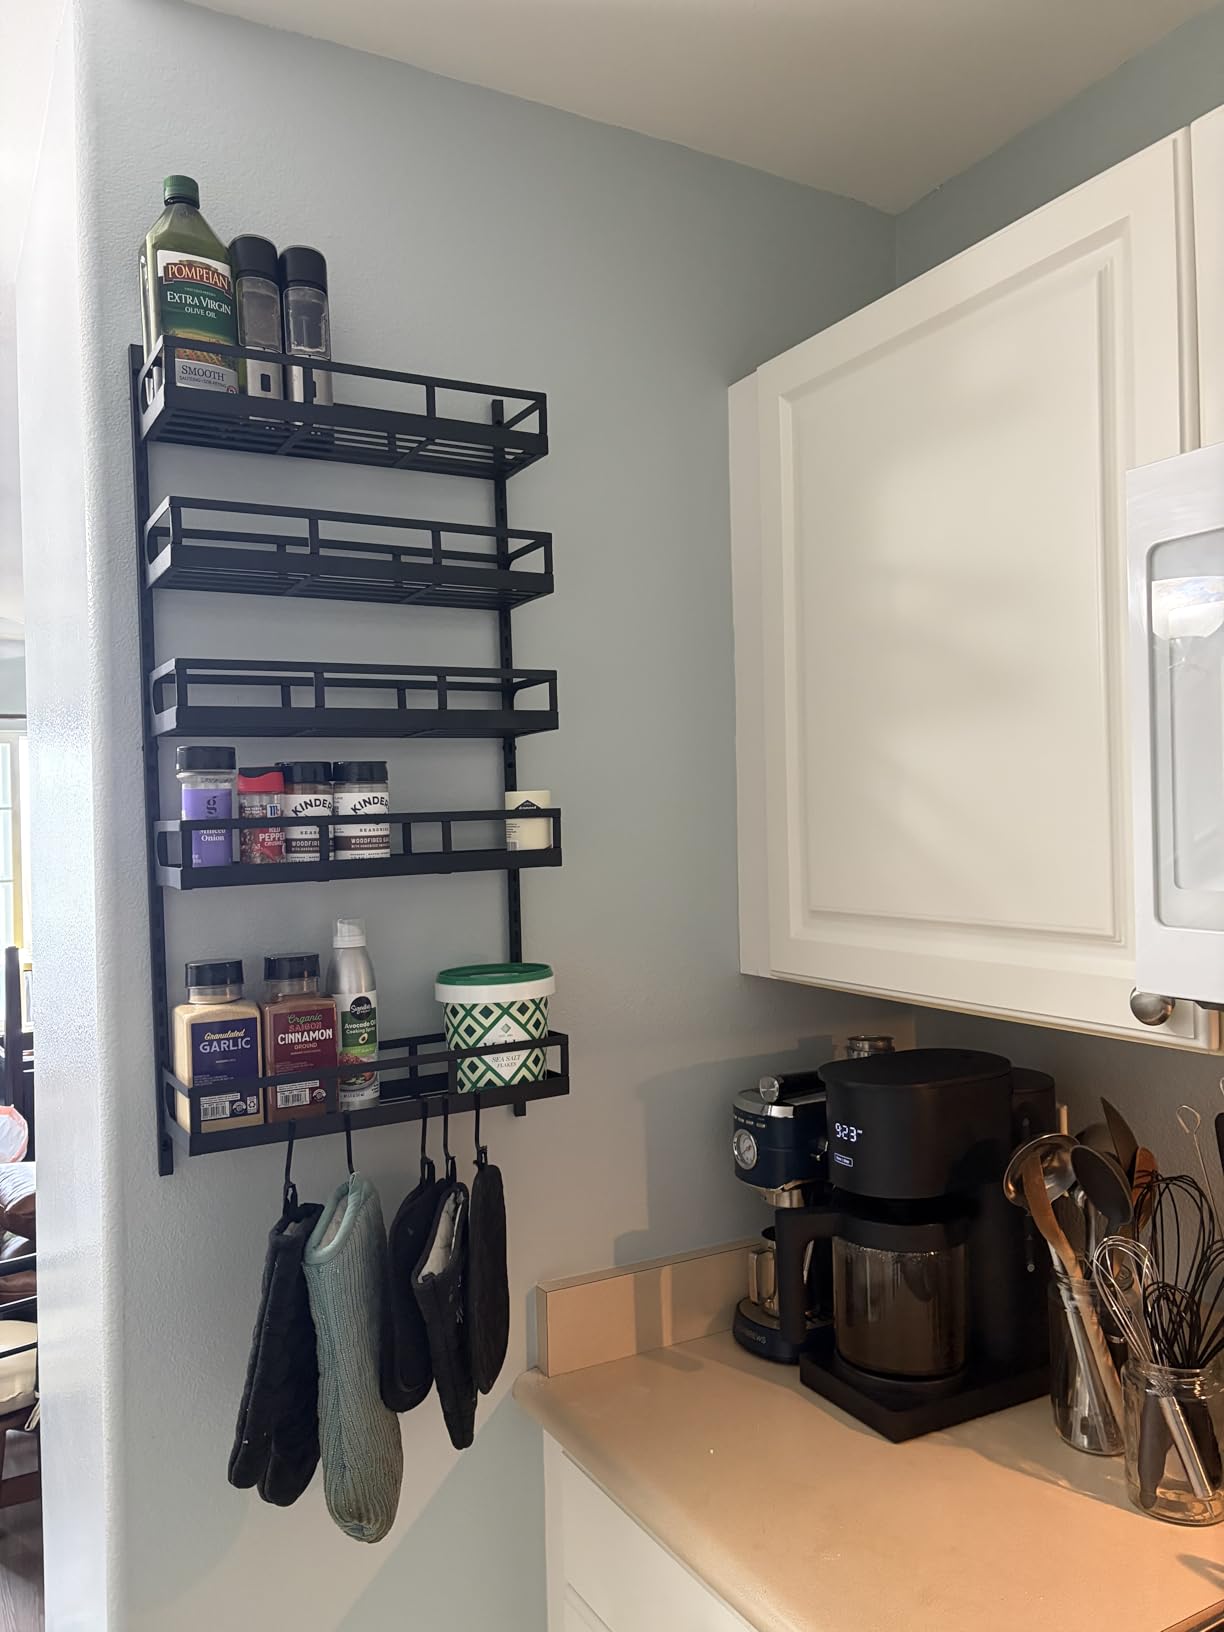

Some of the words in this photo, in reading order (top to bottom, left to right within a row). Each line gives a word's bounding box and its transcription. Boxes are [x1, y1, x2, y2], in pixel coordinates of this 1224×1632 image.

[168, 264, 228, 290] POMPEIAN
[167, 291, 200, 306] EXTRA
[200, 296, 231, 315] VIRGIN
[185, 306, 205, 316] OLIVE
[206, 310, 217, 319] OIL
[181, 364, 225, 382] SMOOTH
[200, 834, 225, 842] Onion
[288, 1013, 323, 1024] Organic
[344, 1020, 370, 1029] Avocado
[204, 1029, 246, 1040] Granulated
[277, 1028, 333, 1045] CINNAMON
[200, 1038, 251, 1053] GARLIC
[294, 1042, 318, 1050] GROUND
